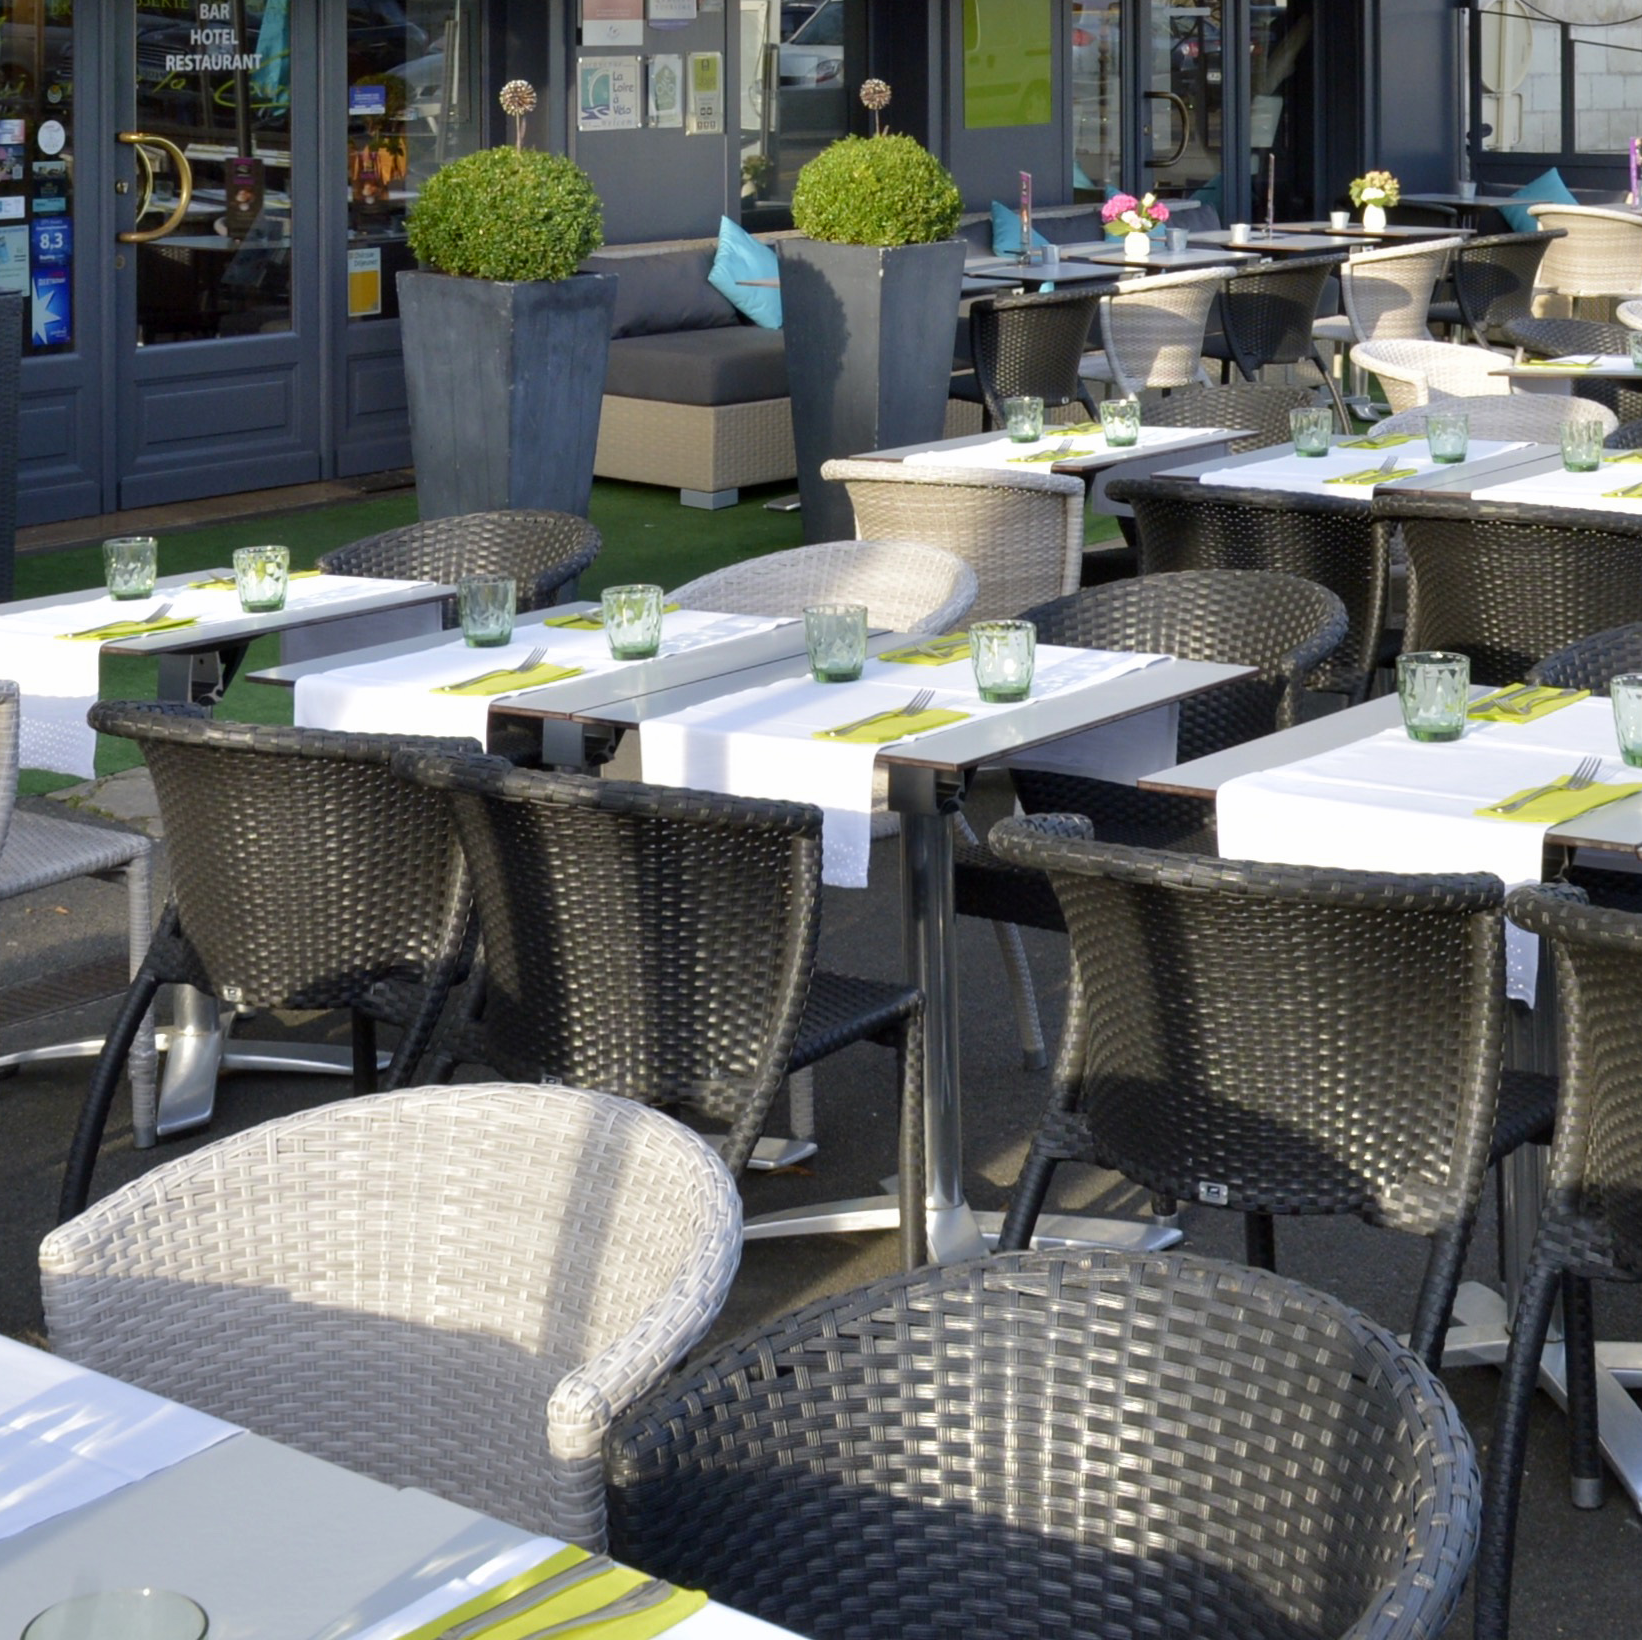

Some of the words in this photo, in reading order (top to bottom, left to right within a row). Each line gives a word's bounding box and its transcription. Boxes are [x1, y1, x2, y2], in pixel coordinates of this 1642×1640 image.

[200, 3, 231, 20] BAR
[190, 28, 240, 46] HOTEL
[165, 53, 263, 72] RESTAURANT
[612, 71, 623, 82] La
[612, 83, 635, 93] Loire
[39, 232, 64, 249] 8,3
